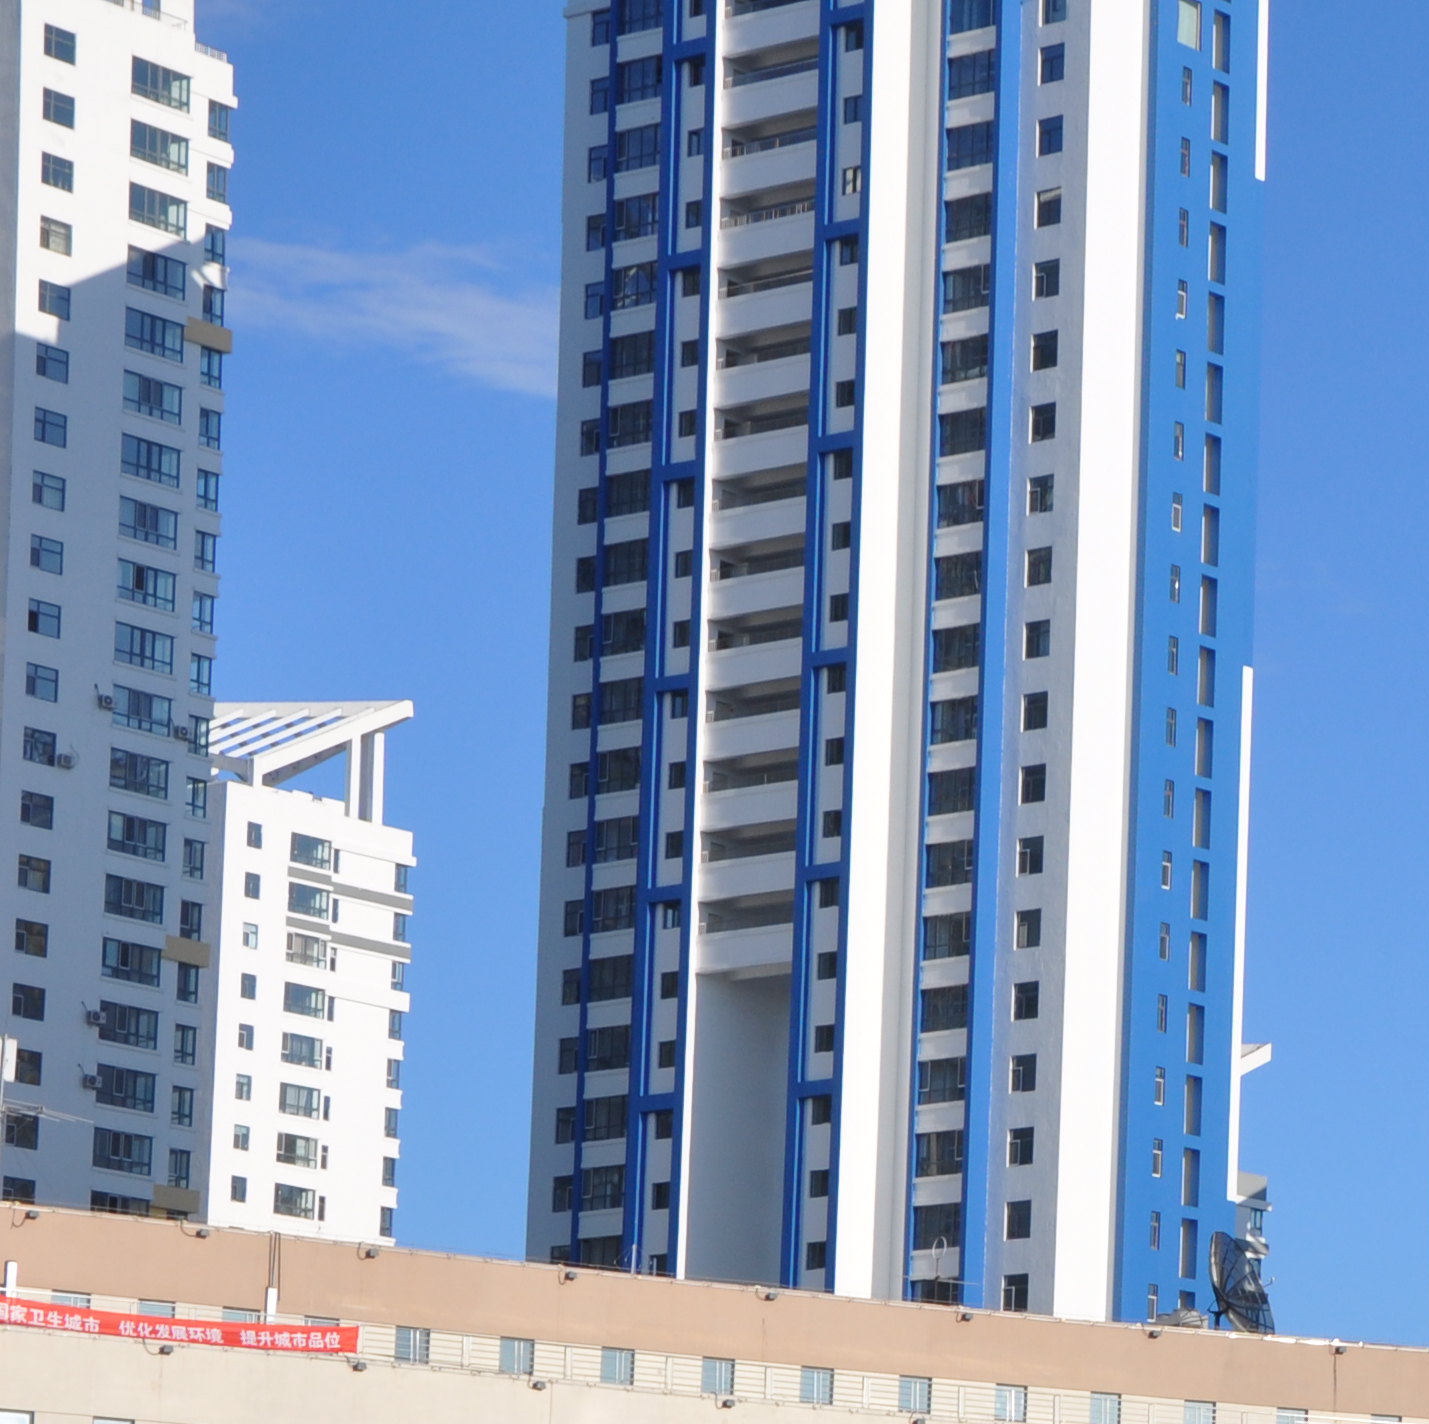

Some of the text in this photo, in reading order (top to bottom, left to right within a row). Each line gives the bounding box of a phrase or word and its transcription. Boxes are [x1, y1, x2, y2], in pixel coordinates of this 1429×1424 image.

[118, 1319, 224, 1344] 优化发展环境
[240, 1329, 341, 1348] 提升城市品位
